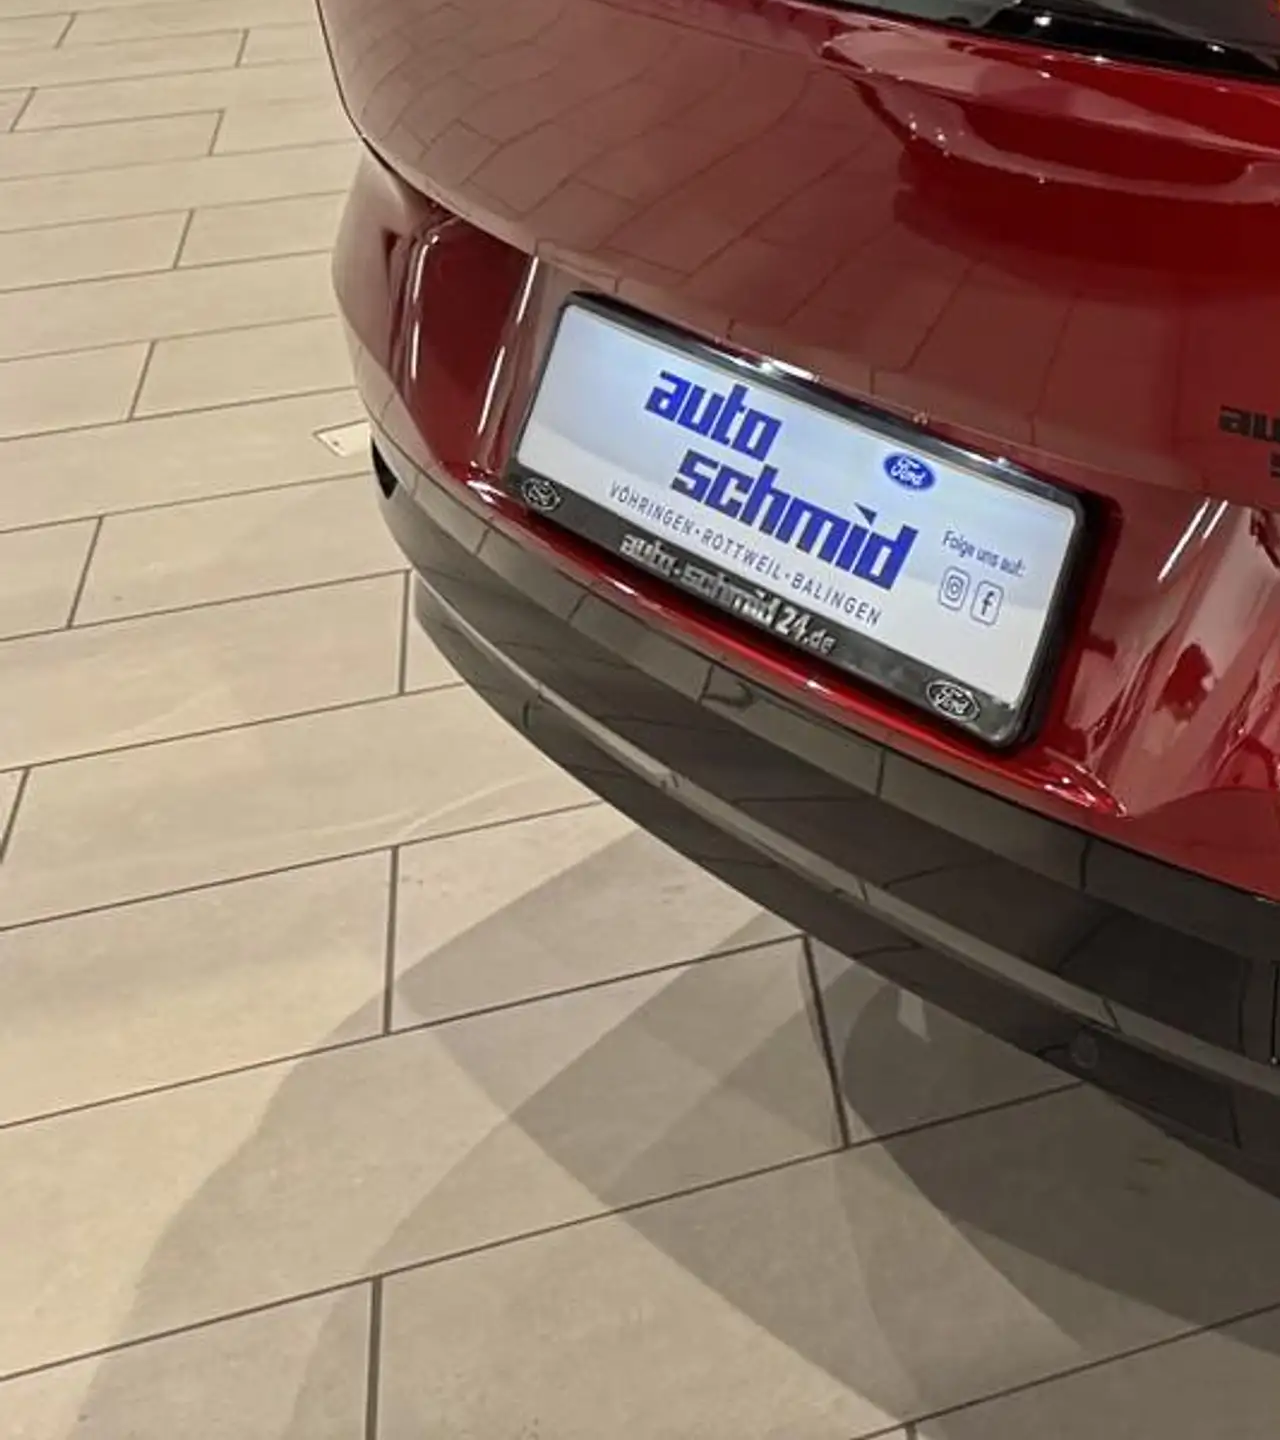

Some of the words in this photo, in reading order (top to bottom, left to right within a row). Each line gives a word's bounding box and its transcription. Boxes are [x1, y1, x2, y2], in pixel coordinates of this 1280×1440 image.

[644, 370, 782, 462] auto
[889, 455, 928, 487] Ford
[670, 449, 919, 591] schmid
